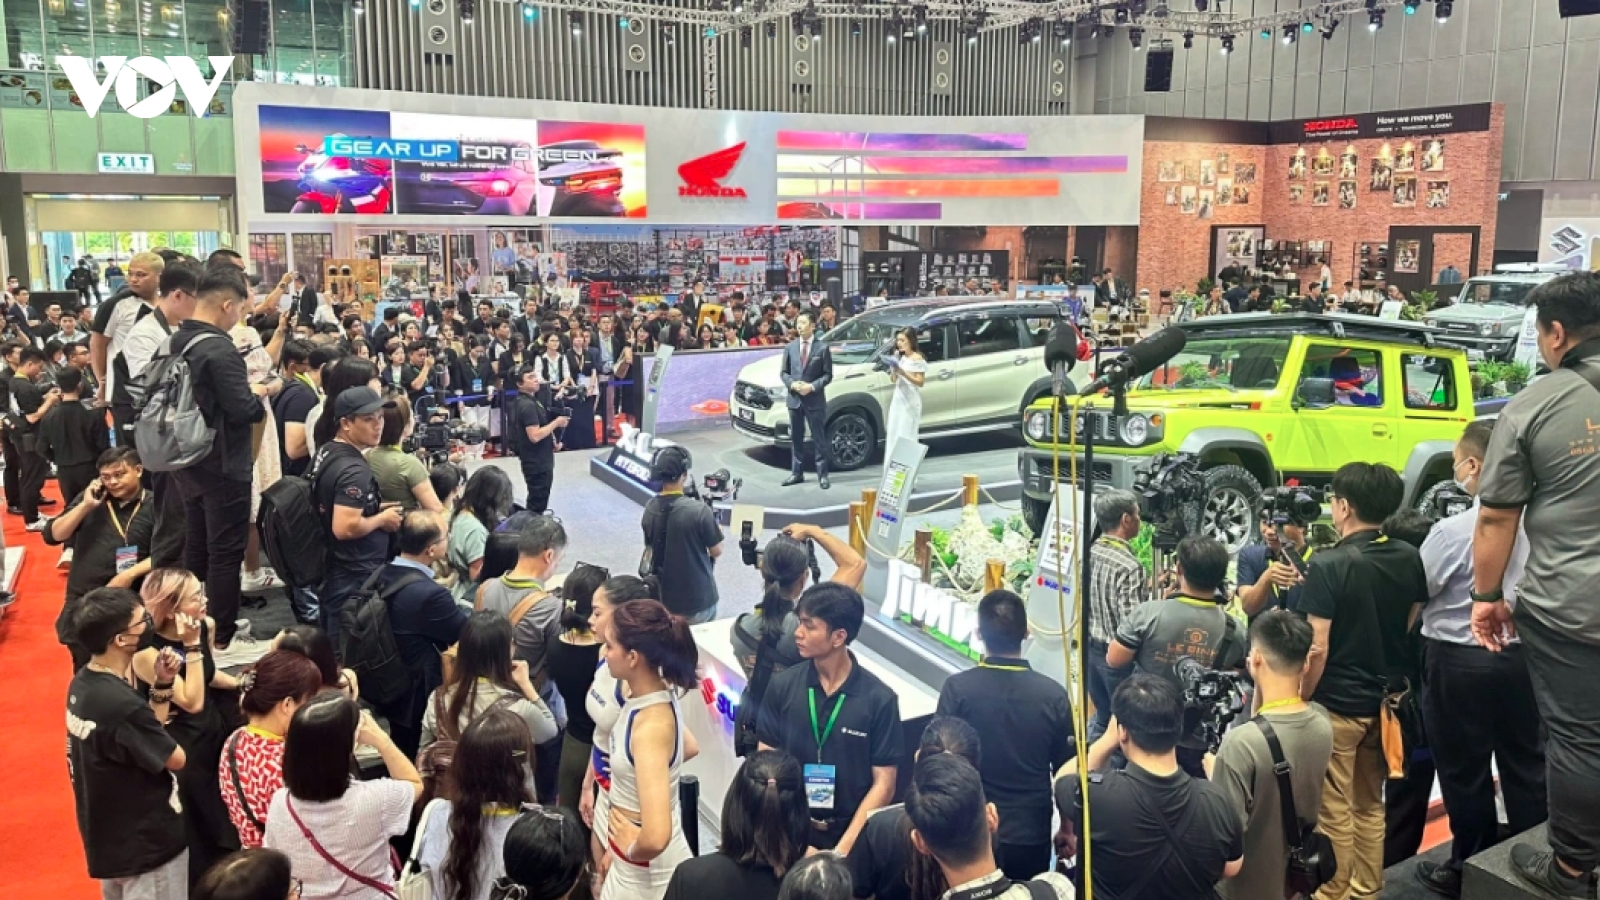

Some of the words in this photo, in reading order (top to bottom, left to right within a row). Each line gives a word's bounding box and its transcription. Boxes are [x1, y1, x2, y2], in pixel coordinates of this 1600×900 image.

[1304, 118, 1358, 131] HONDA
[1377, 116, 1395, 125] How
[1411, 114, 1434, 122] move
[331, 141, 411, 157] GEAR
[419, 144, 452, 158] UP
[461, 145, 507, 161] FOR
[511, 147, 597, 163] GREEN
[102, 156, 149, 167] EXIT
[678, 186, 748, 198] HONDA
